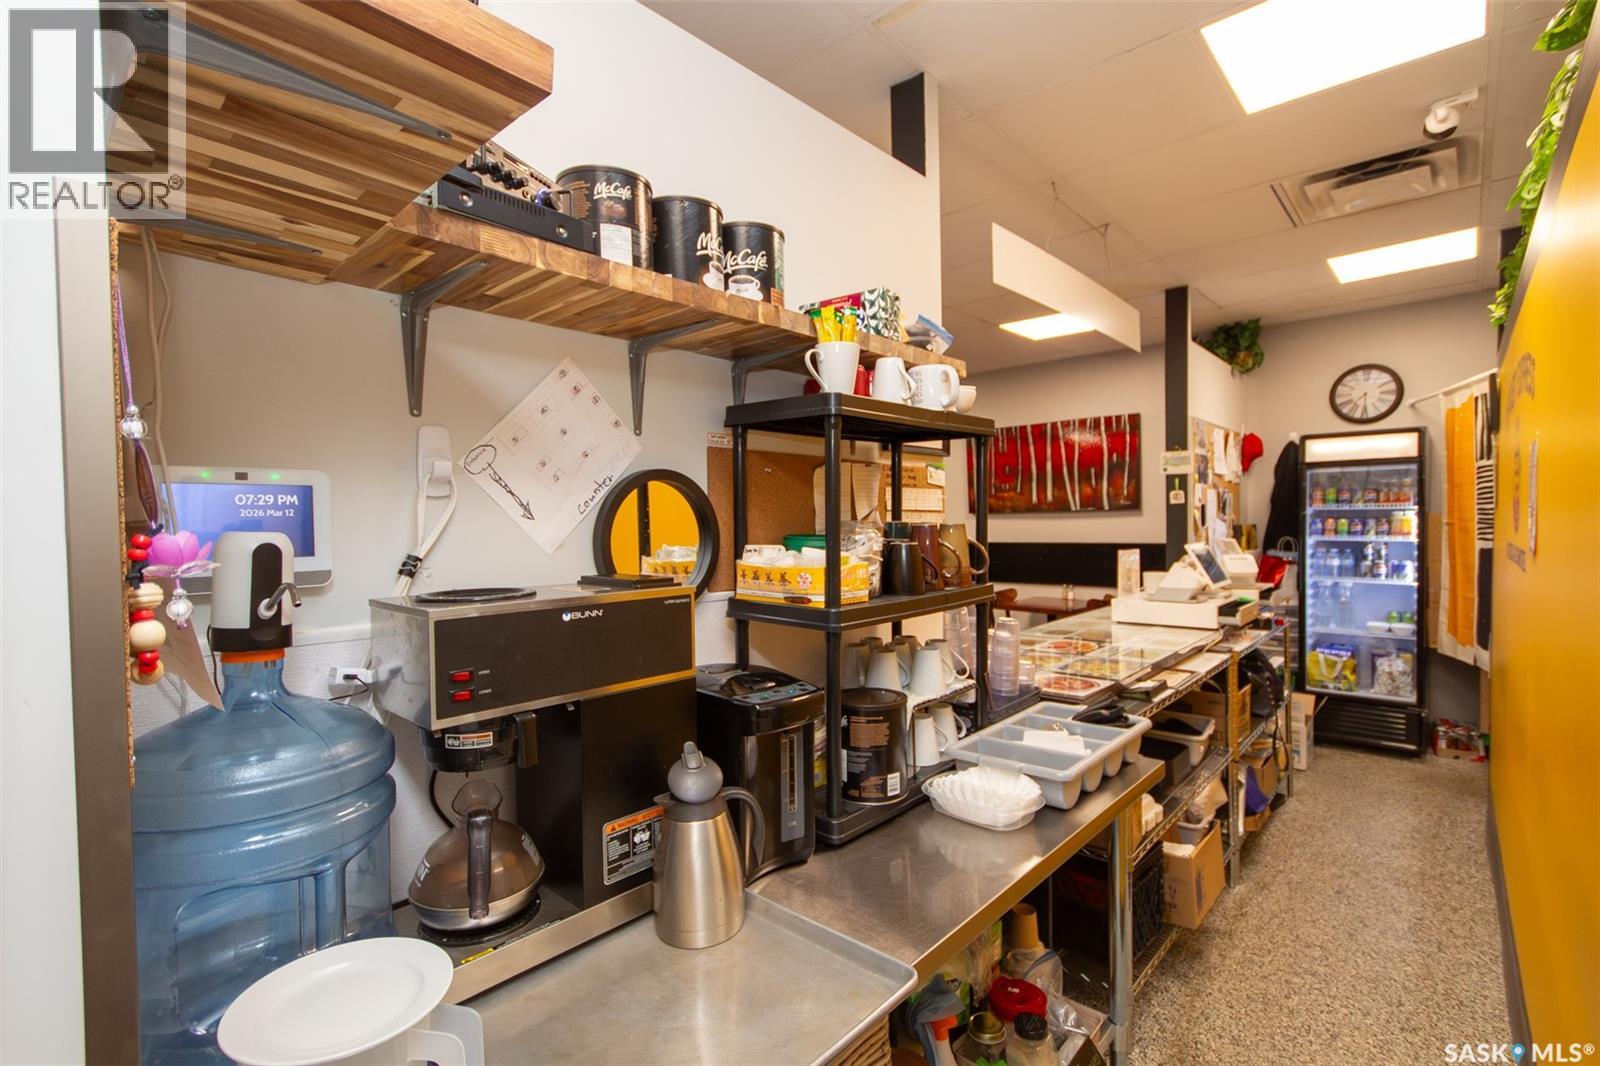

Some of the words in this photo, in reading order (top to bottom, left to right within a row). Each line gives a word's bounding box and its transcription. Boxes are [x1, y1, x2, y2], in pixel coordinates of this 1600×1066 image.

[234, 494, 275, 506] 07:29
[277, 494, 299, 506] PM
[240, 508, 265, 517] 2026
[266, 509, 283, 517] Mar
[285, 508, 295, 517] 12
[571, 609, 604, 620] BUNN
